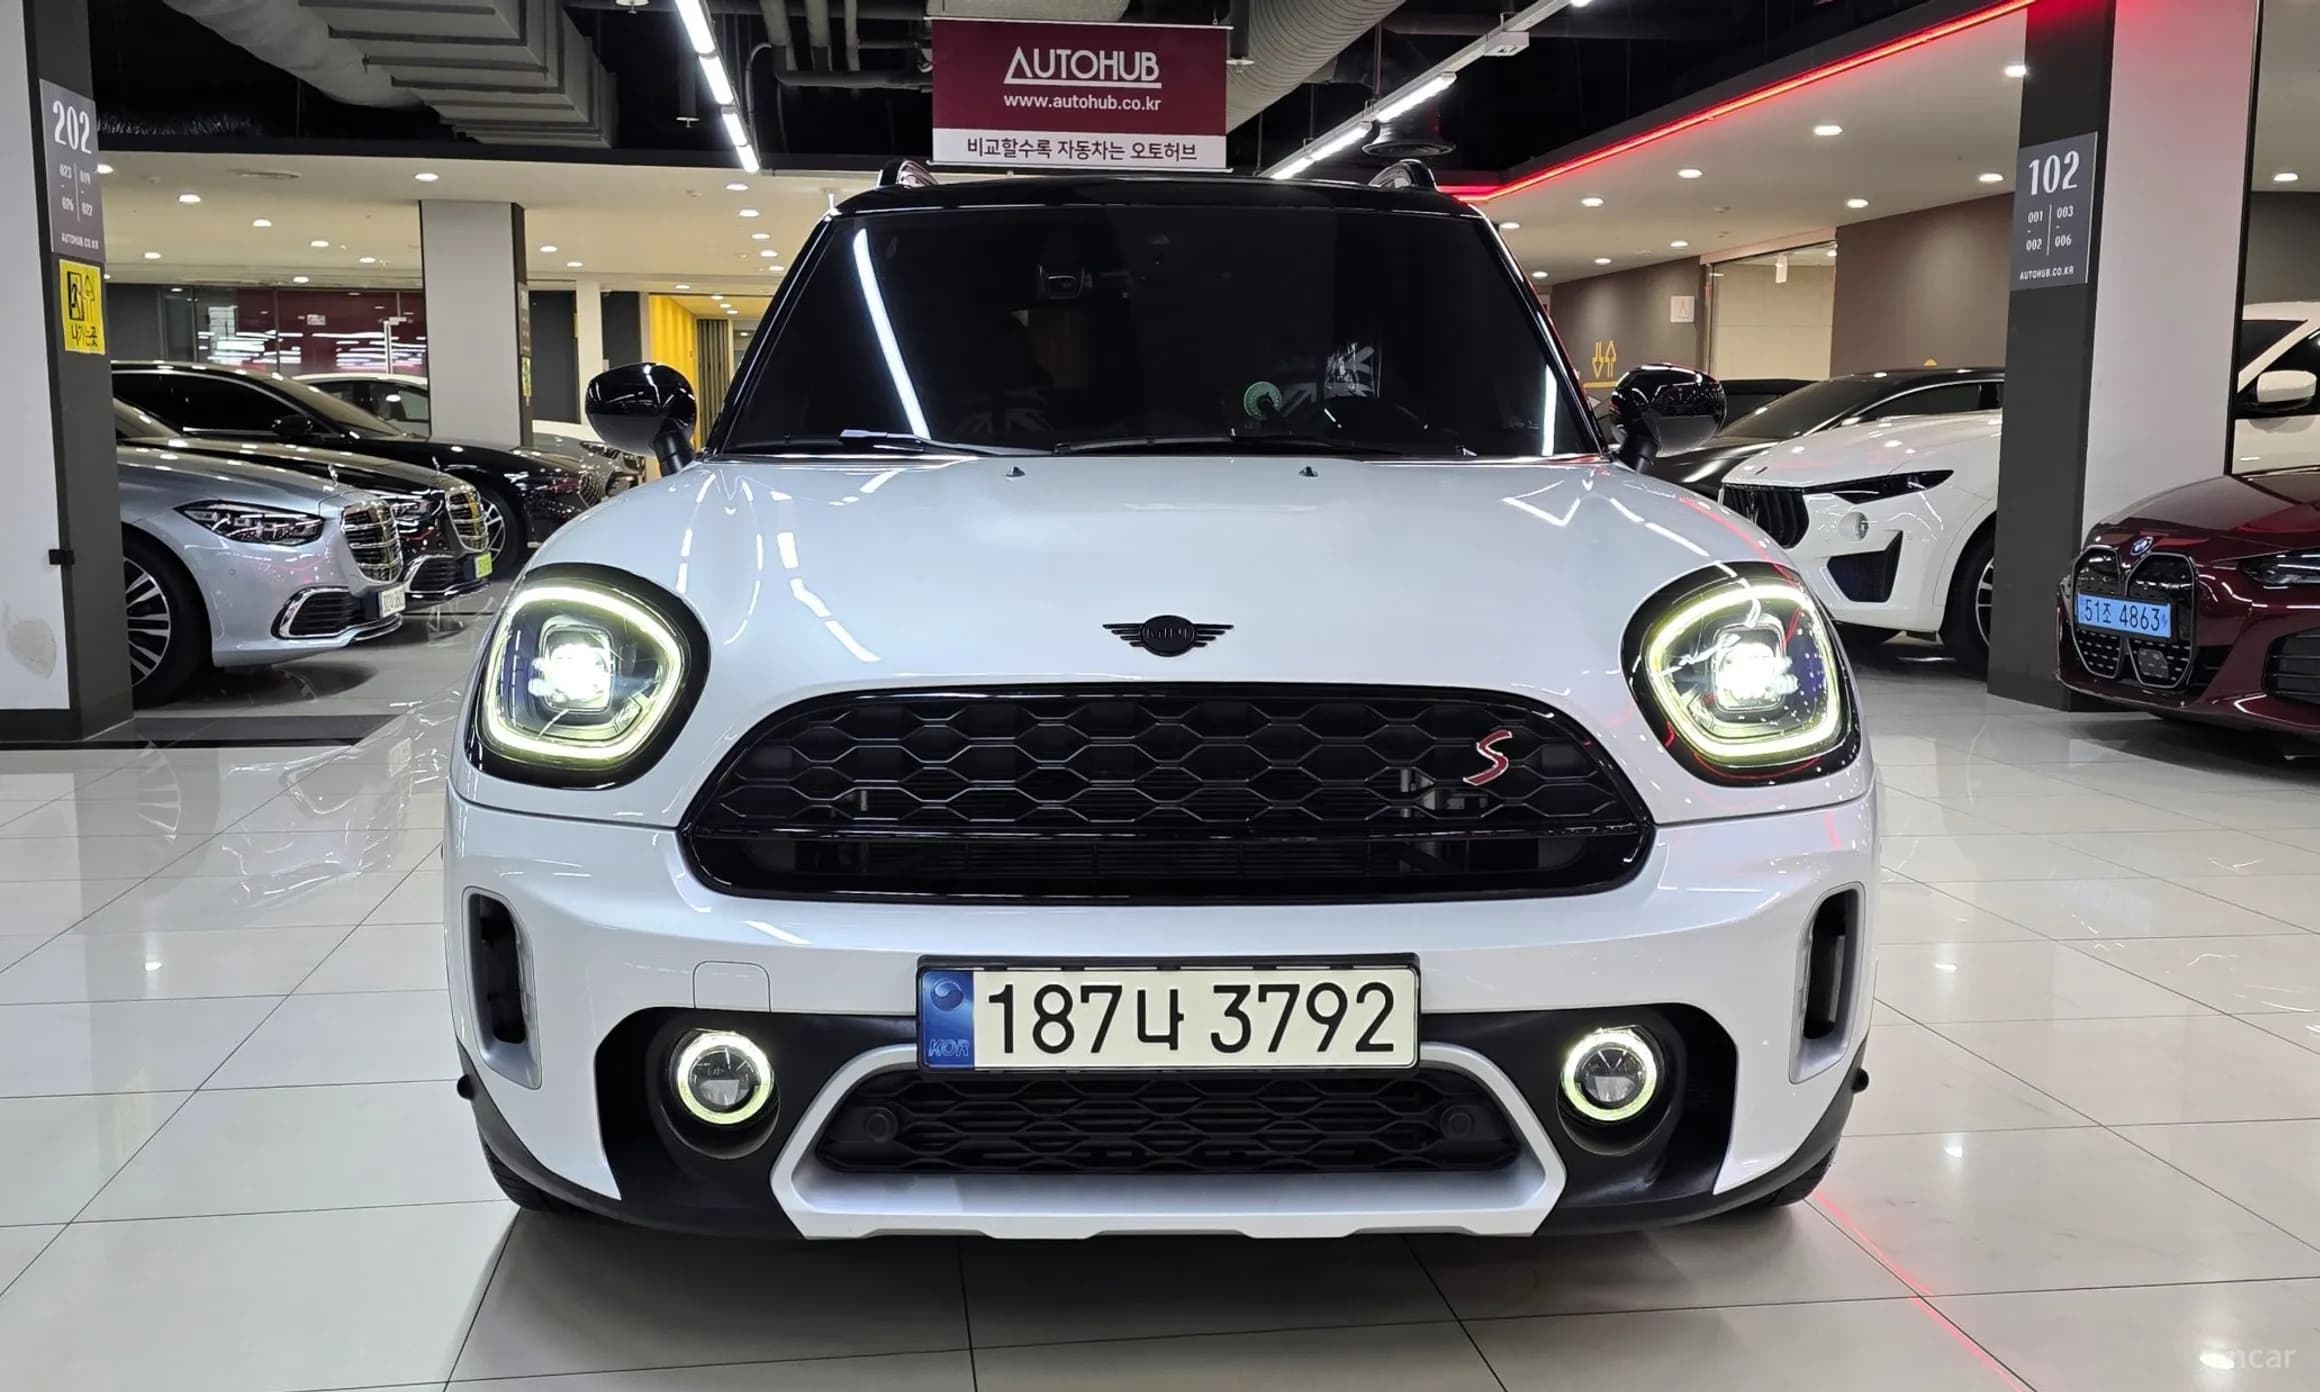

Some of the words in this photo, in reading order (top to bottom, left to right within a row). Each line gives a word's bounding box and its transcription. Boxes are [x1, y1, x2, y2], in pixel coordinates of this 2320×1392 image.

[1003, 46, 1162, 87] AUTOHUB
[1004, 94, 1161, 112] www.autohub.co.kr
[53, 100, 92, 155] 202
[967, 137, 1051, 159] 비교할수록
[1057, 139, 1126, 161] 자동차는
[1130, 142, 1198, 162] 오토허브
[2028, 150, 2080, 196] 102
[2027, 210, 2044, 224] 001
[2056, 204, 2075, 219] 003
[2025, 238, 2043, 252] 002
[2054, 233, 2072, 248] 006
[2019, 264, 2075, 281] AUTOHUB.CO.KR
[2084, 599, 2112, 625] 51조
[2119, 604, 2161, 632] 4863
[1462, 728, 1513, 787] S
[987, 983, 1184, 1055] 187나
[1210, 981, 1395, 1054] 3792
[927, 1038, 970, 1057] KOR
